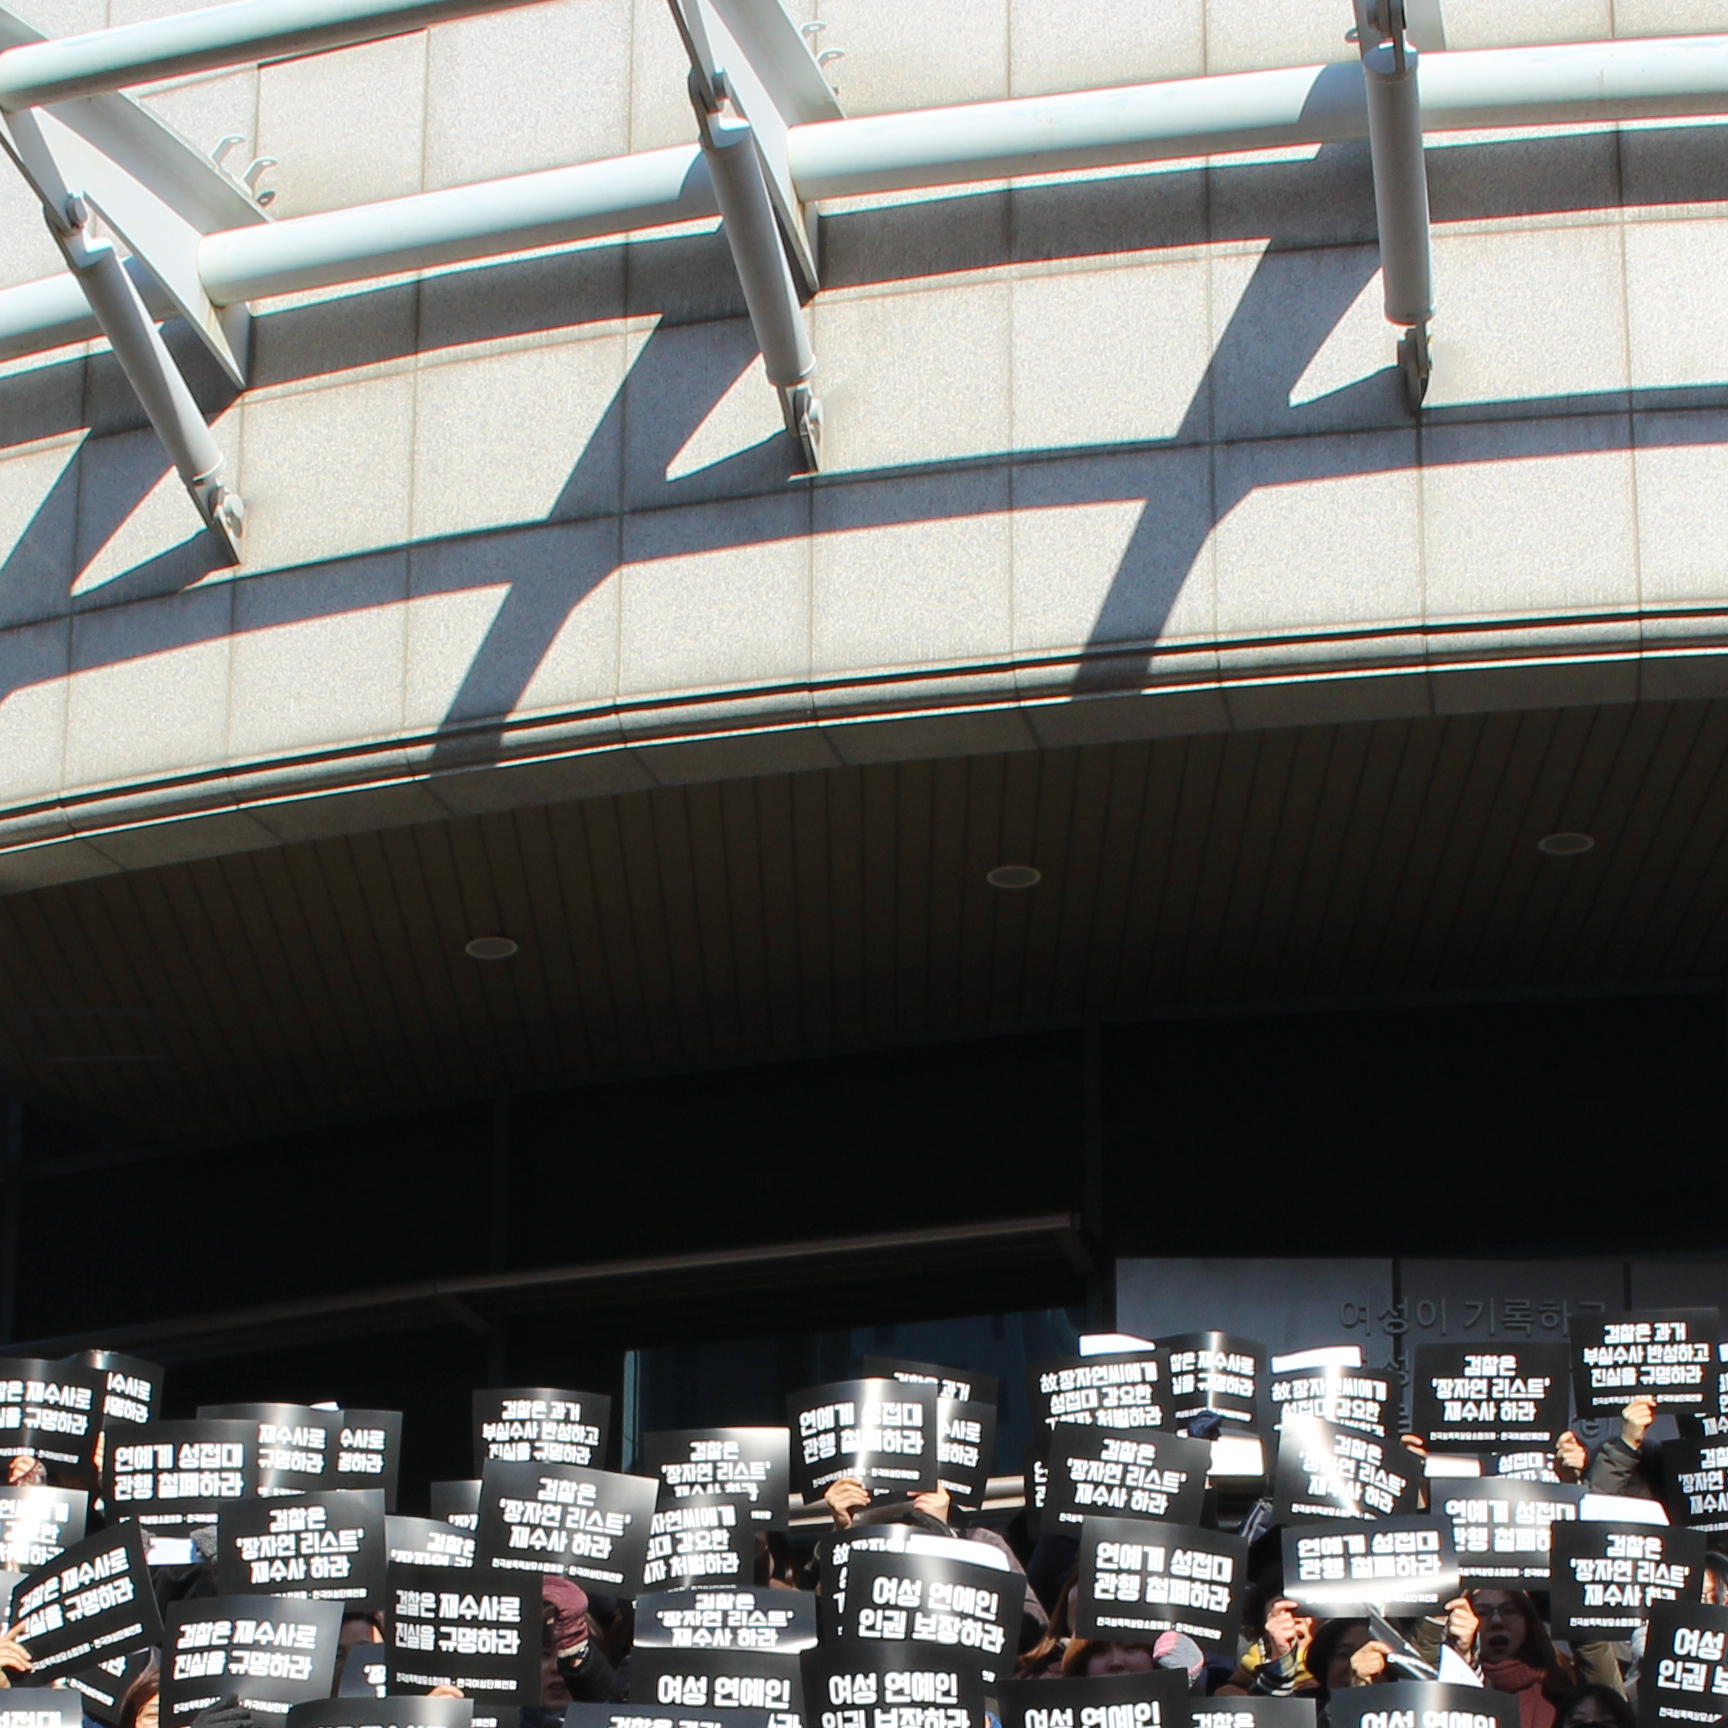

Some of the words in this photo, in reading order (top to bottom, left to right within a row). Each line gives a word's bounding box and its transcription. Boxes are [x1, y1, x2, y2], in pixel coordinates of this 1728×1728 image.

[1605, 1324, 1651, 1344] 검찰은
[1465, 1355, 1516, 1376] 검찰은
[1584, 1345, 1644, 1366] 부실수사
[1647, 1344, 1709, 1363] 반성하고
[1591, 1367, 1637, 1387] 진실을
[1640, 1365, 1702, 1384] 규명하라
[1444, 1401, 1496, 1421] 재수사
[1500, 1401, 1536, 1421] 하라
[1097, 1542, 1165, 1572] 연예계
[1170, 1550, 1232, 1582] 성접대
[1095, 1573, 1140, 1601] 관행
[1146, 1575, 1230, 1612] 철폐하라
